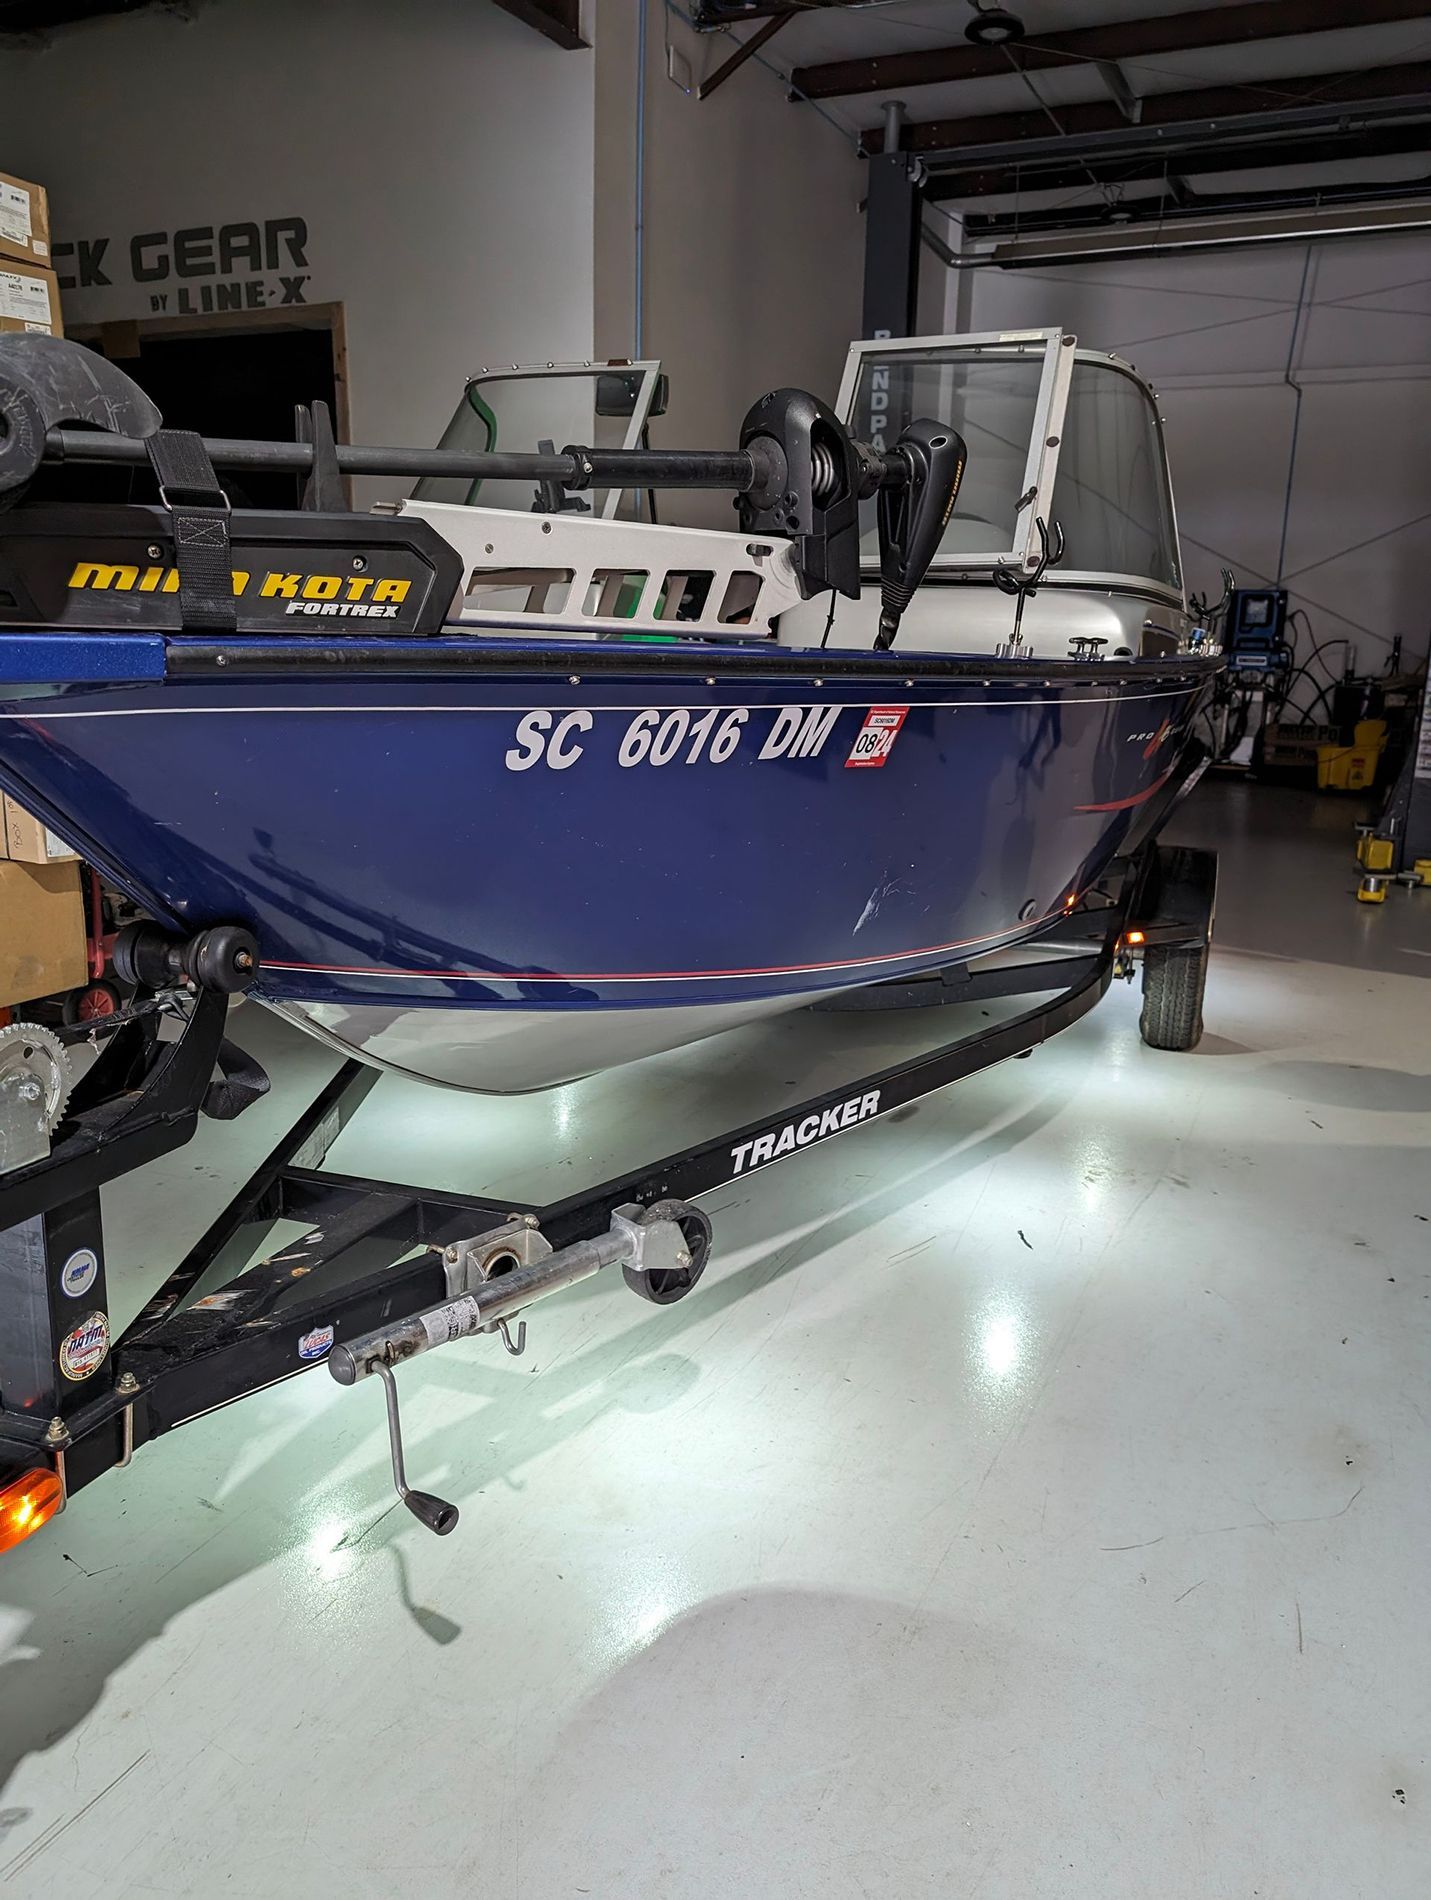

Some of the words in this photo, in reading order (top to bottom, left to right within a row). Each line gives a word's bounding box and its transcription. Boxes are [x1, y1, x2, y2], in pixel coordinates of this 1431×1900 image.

[130, 217, 309, 283] GEAR
[151, 294, 168, 312] BY
[260, 572, 412, 603] KOTA
[285, 601, 401, 618] FORTREX
[505, 710, 593, 771] SC
[618, 708, 749, 767] 6016
[757, 706, 843, 761] DM
[855, 733, 878, 753] 08
[1126, 731, 1155, 742] PRO
[730, 1089, 881, 1174] TRACKER
